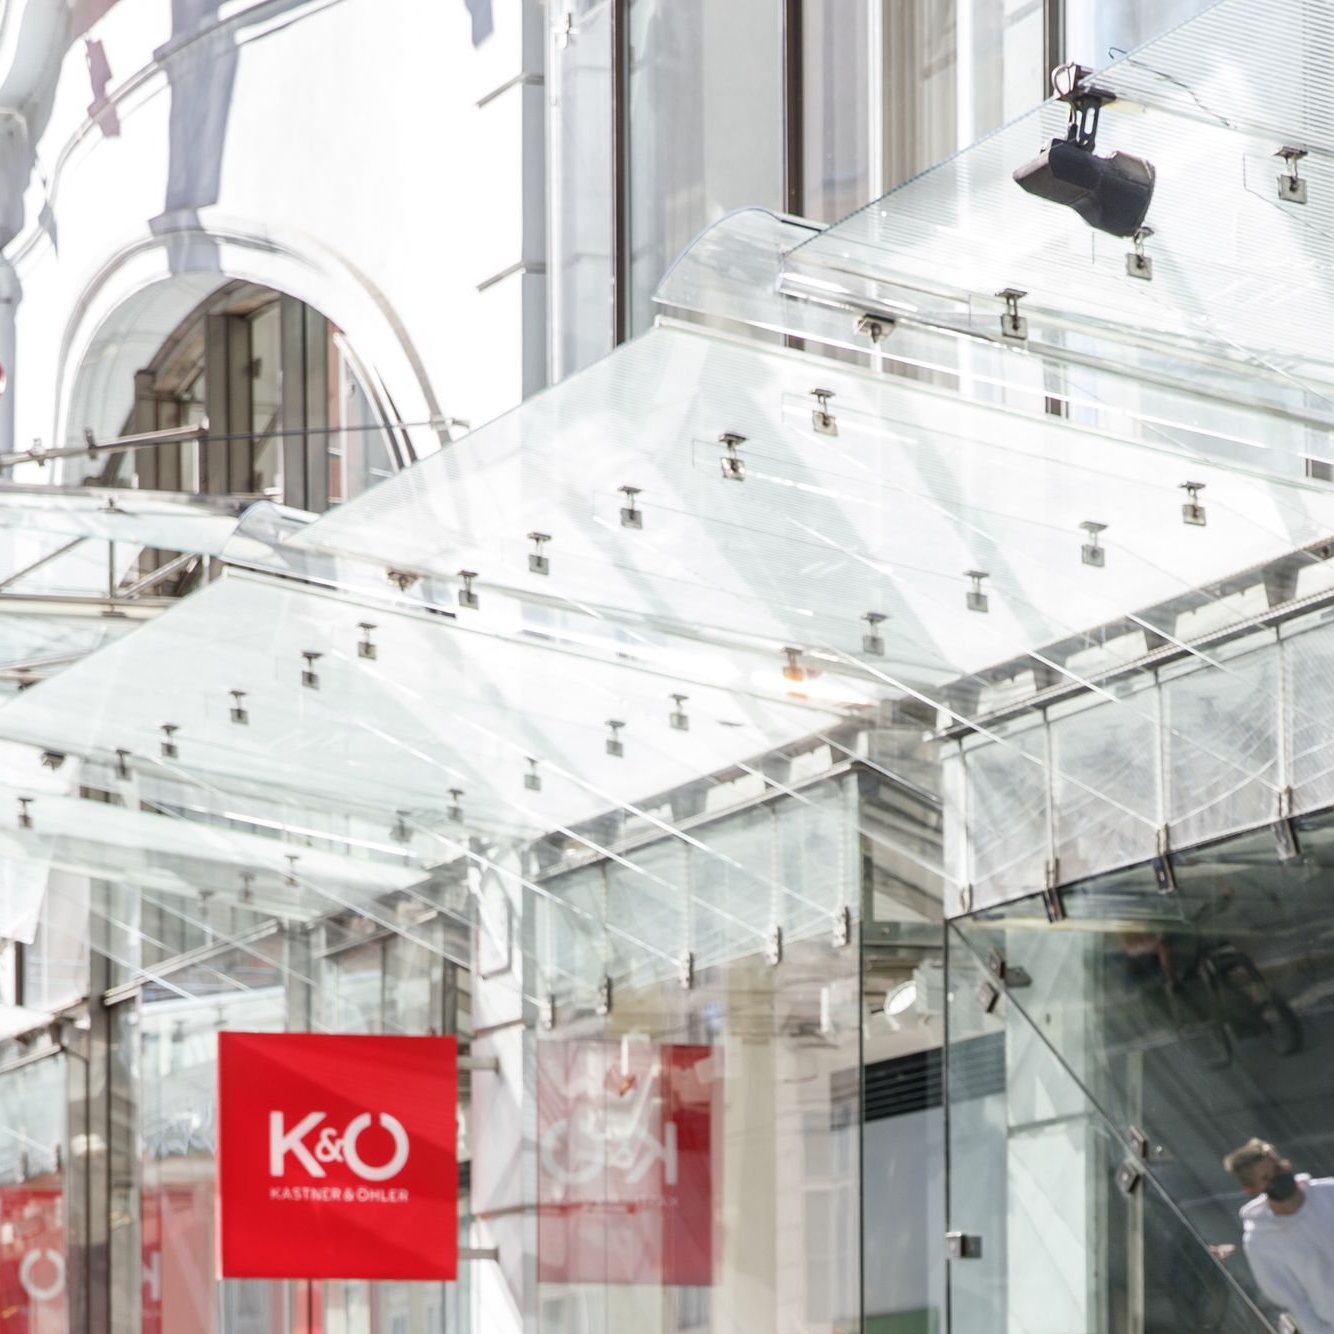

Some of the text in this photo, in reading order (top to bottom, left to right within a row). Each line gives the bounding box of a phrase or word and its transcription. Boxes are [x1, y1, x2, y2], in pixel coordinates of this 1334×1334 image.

[270, 1110, 410, 1182] K&O
[270, 1186, 341, 1202] KASTNER
[355, 1187, 409, 1203] ÖHLER
